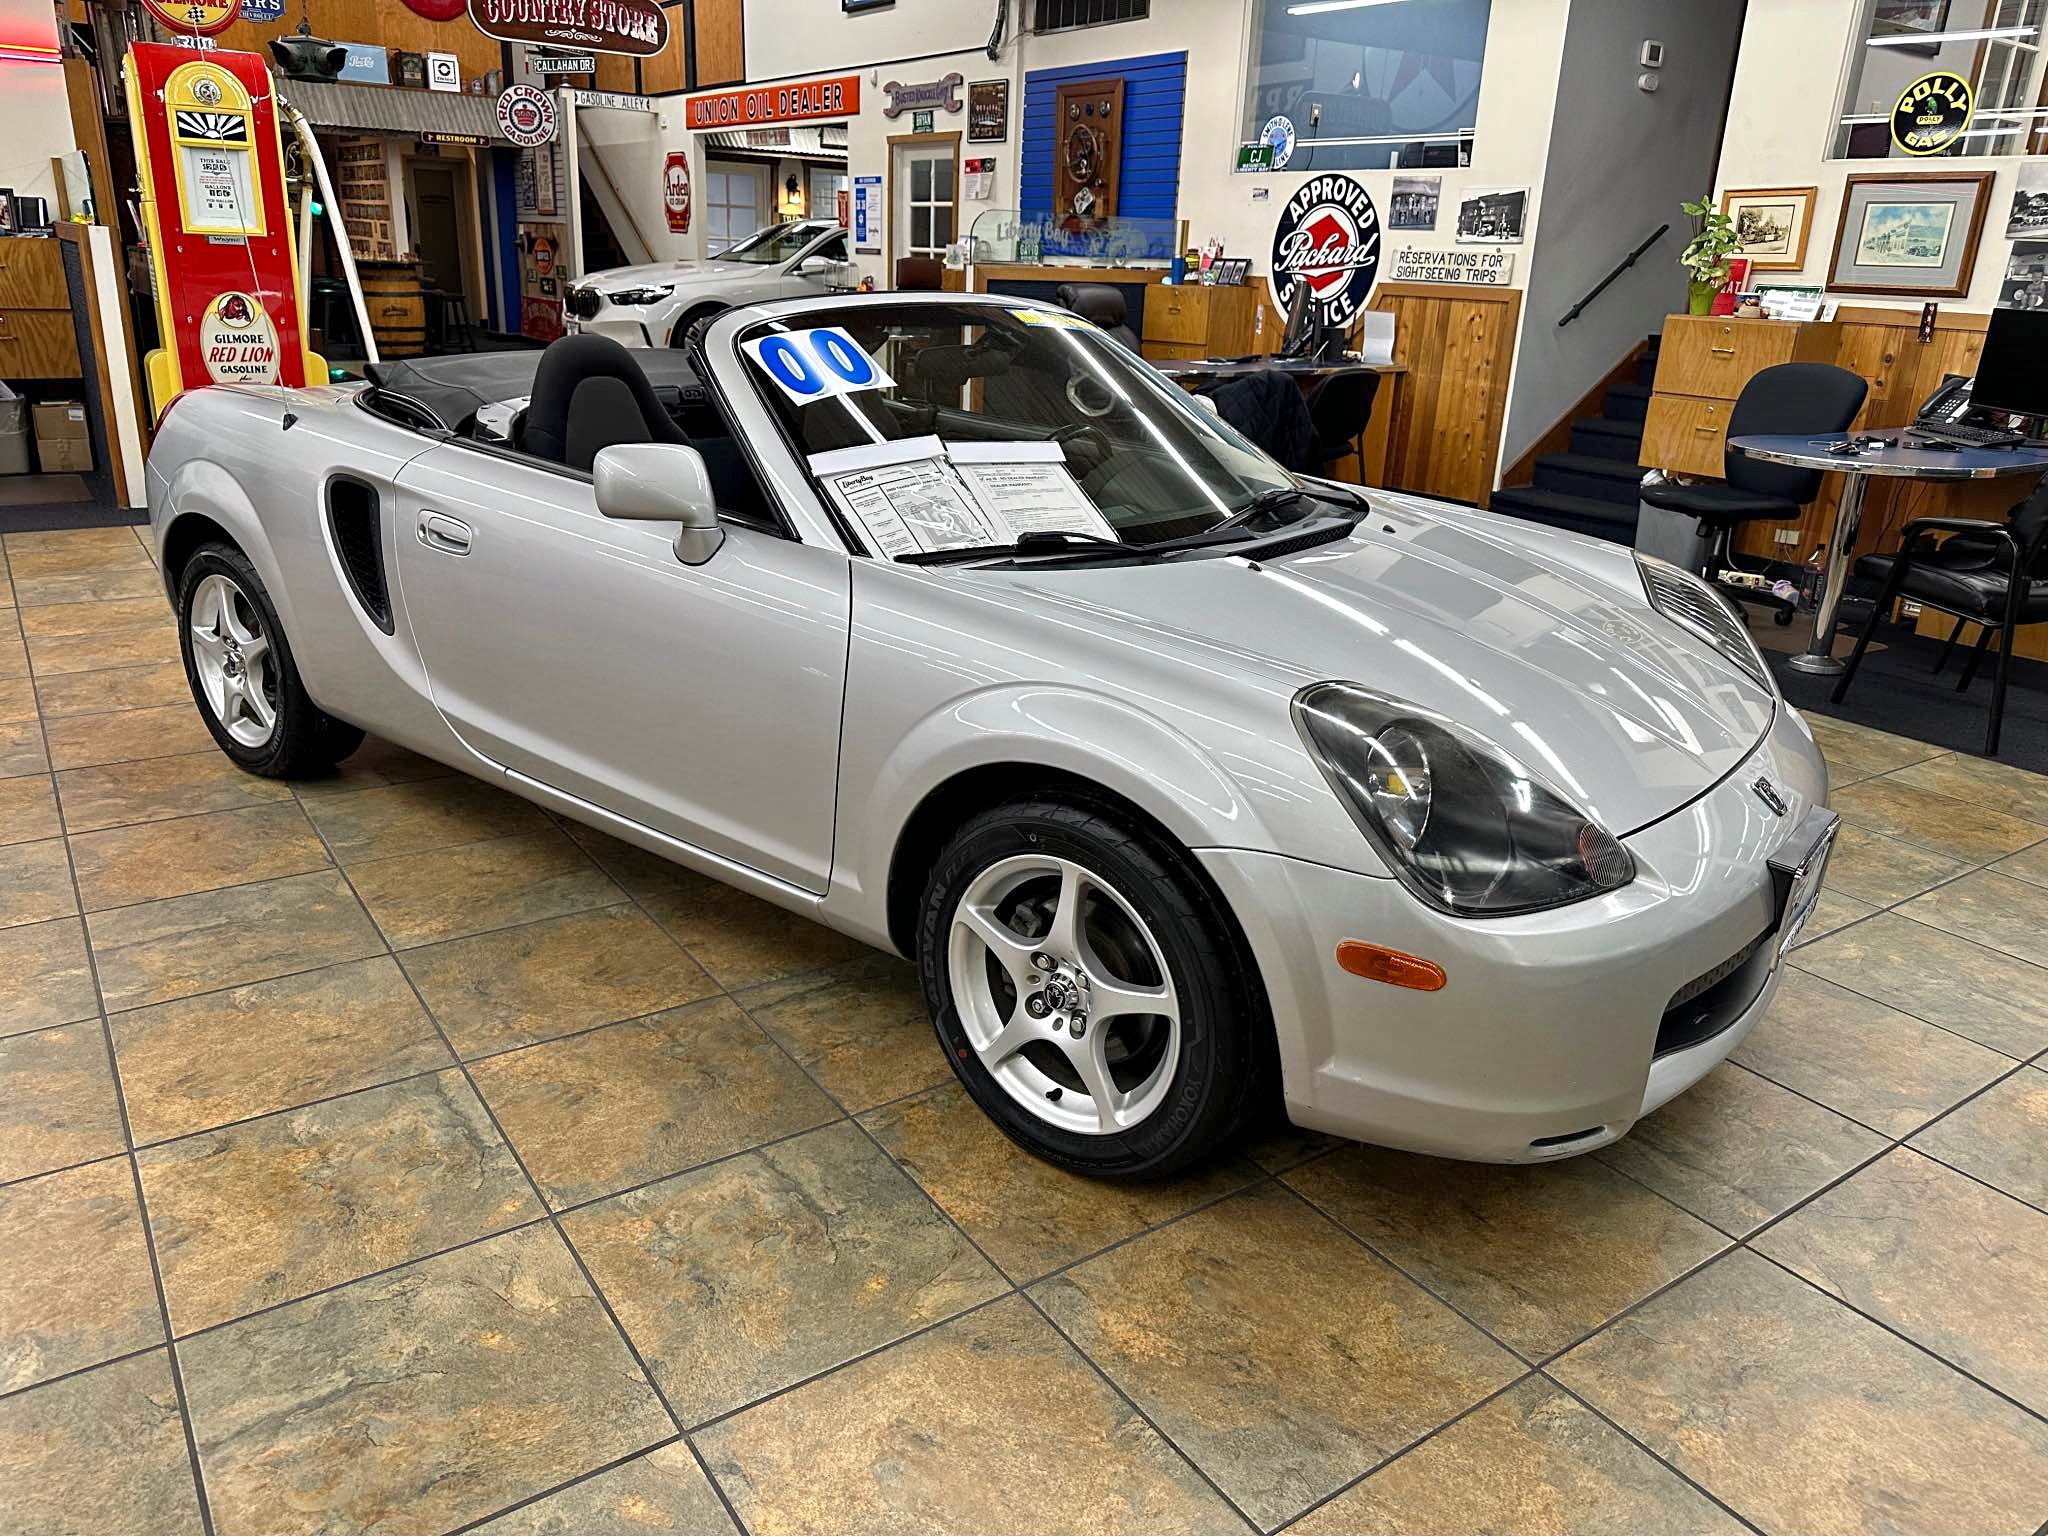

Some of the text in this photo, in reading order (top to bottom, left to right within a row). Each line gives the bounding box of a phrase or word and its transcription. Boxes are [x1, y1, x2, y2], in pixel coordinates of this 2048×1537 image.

[482, 0, 659, 45] COUNTRY STORE
[536, 58, 578, 72] CALLAHAN
[580, 93, 644, 110] GASOLINE ALLEY
[694, 82, 844, 125] UNION OIL DEALER
[1900, 78, 1967, 113] POLLY
[499, 87, 553, 124] RED CROWN
[436, 134, 477, 143] RESTROOM
[504, 125, 550, 144] GASOLINE
[1904, 130, 1948, 147] GAS
[1250, 150, 1263, 163] CJ
[665, 173, 688, 196] Arden
[1289, 177, 1375, 229] APPROVED
[997, 220, 1042, 242] Liberty
[1274, 230, 1379, 272] Packard
[1399, 251, 1504, 267] RESERVATIONS FOR
[1397, 265, 1497, 282] SIGHTSEEING TRIPS
[1280, 282, 1354, 326] SICE
[215, 334, 264, 344] GILMORE
[209, 347, 273, 362] RED LION
[759, 329, 881, 396] 00
[220, 365, 268, 374] GASOLINE
